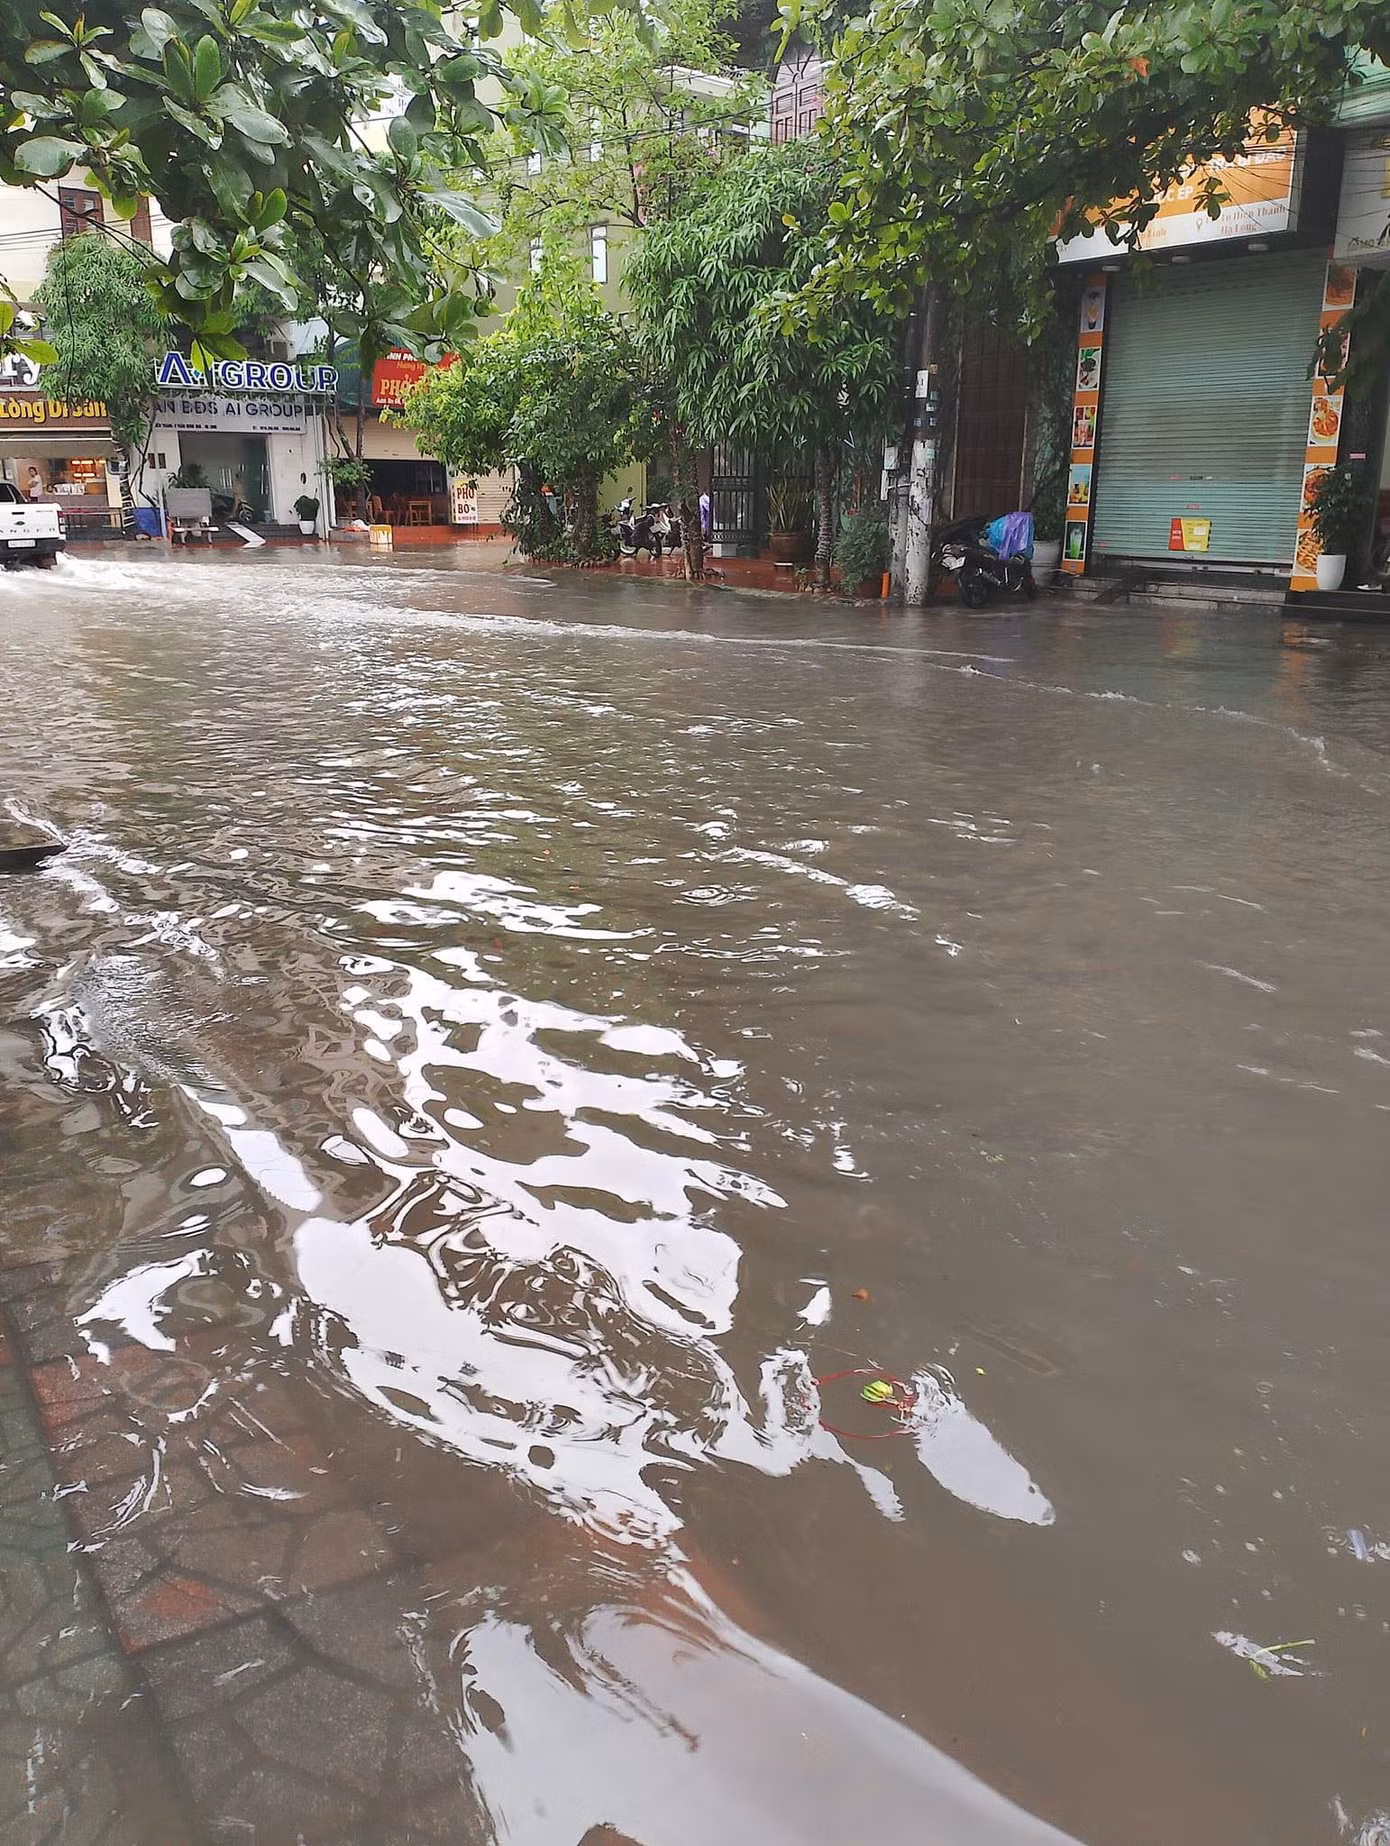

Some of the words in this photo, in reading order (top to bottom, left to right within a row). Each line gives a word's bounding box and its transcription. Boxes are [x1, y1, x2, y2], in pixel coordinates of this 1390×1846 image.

[220, 360, 339, 393] GROUP
[225, 402, 241, 416] AI
[245, 402, 303, 418] GROUP
